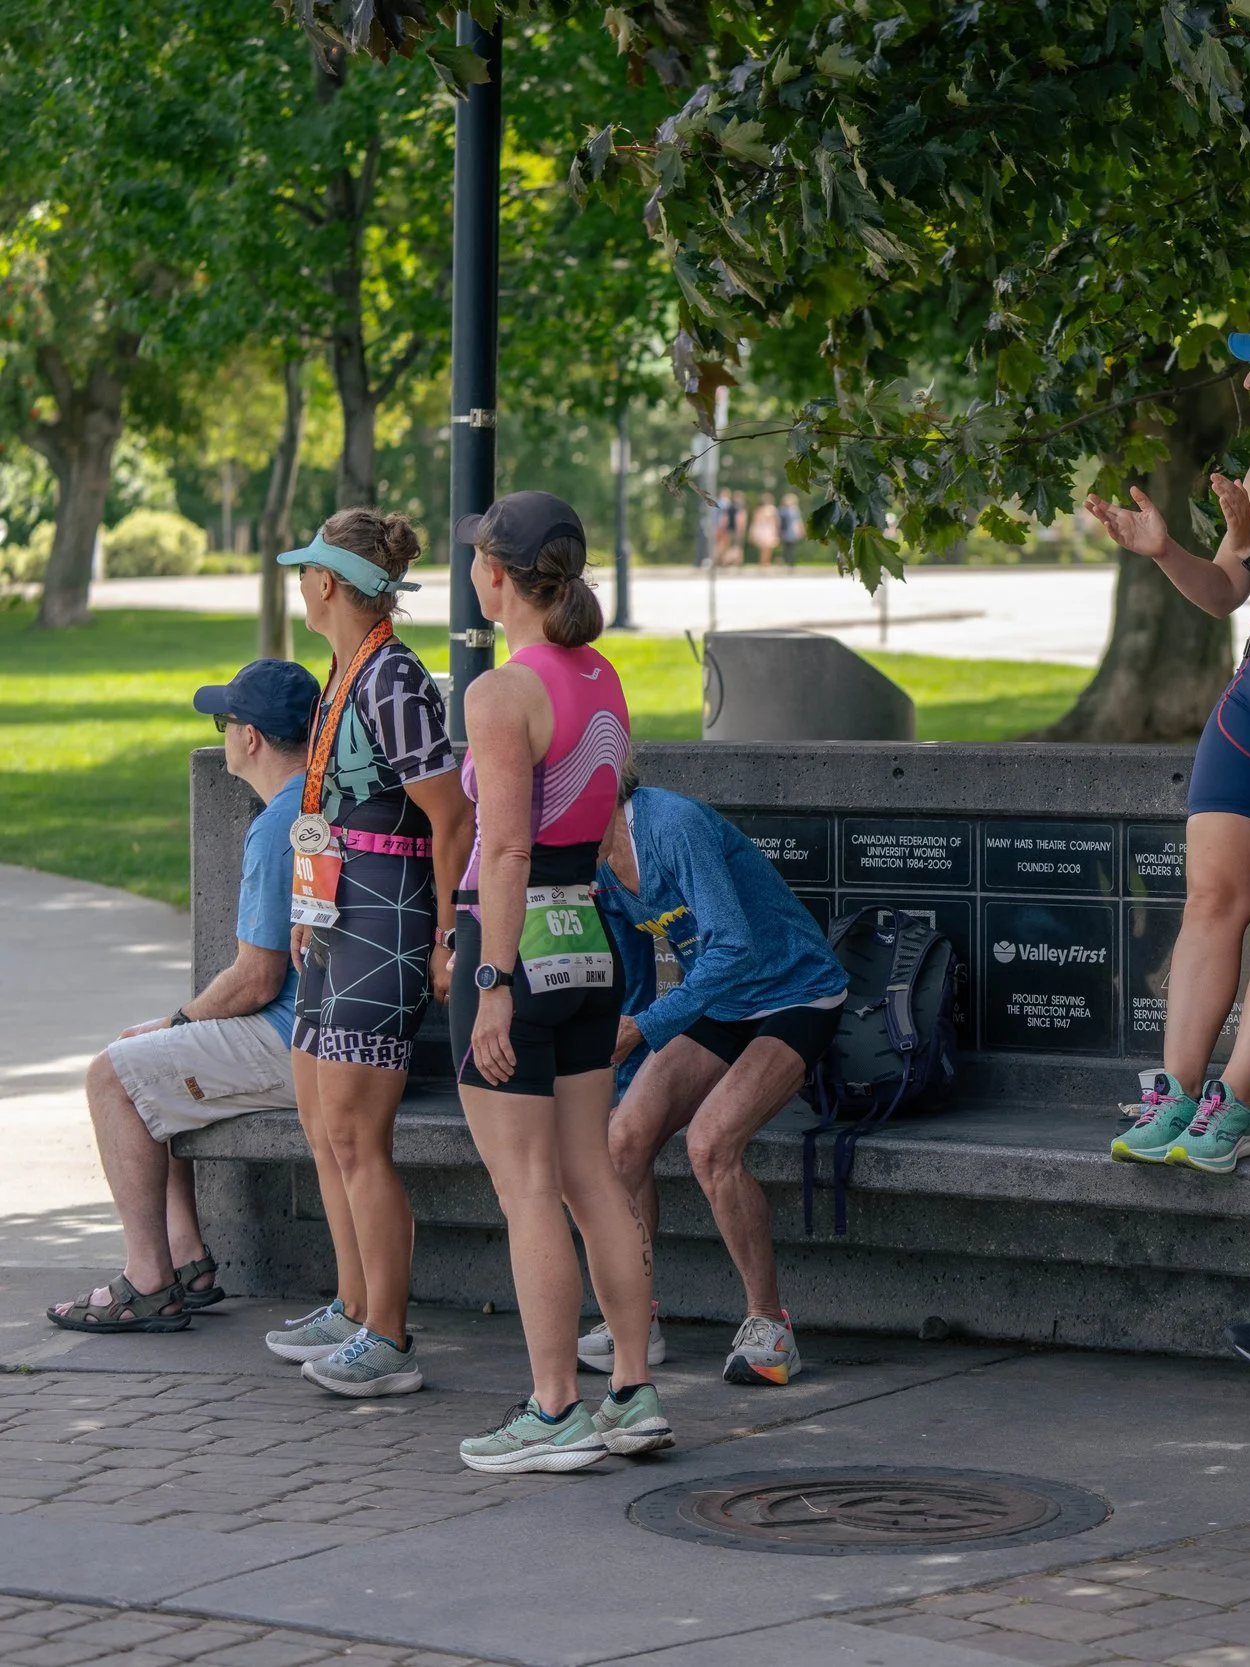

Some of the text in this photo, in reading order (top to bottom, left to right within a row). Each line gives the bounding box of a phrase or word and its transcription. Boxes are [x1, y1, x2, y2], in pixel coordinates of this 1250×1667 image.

[784, 838, 796, 849] OF
[851, 834, 962, 847] CANADIAN FEDERATION OF
[987, 838, 1112, 852] MANY HATS THEATRE COMPANY
[867, 846, 946, 858] UNIVERSITY WOMEN
[1162, 842, 1176, 853] JCI
[783, 850, 809, 860] GIDDY
[1135, 853, 1183, 865] WORLDWIDE
[860, 857, 953, 870] PENTICTON 1984-2009
[1017, 862, 1081, 874] FOUNDED 2008
[1138, 866, 1182, 876] LEADERS &
[545, 909, 584, 936] 625
[1018, 943, 1107, 966] ValleyFirst
[544, 970, 606, 987] FOOD DRINK
[1012, 993, 1085, 1006] PROUDLY SERVING
[1006, 1005, 1091, 1018] THE PENTICTON AREA
[1027, 1017, 1071, 1029] SINCE 1947
[1133, 1021, 1160, 1032] LOCAL
